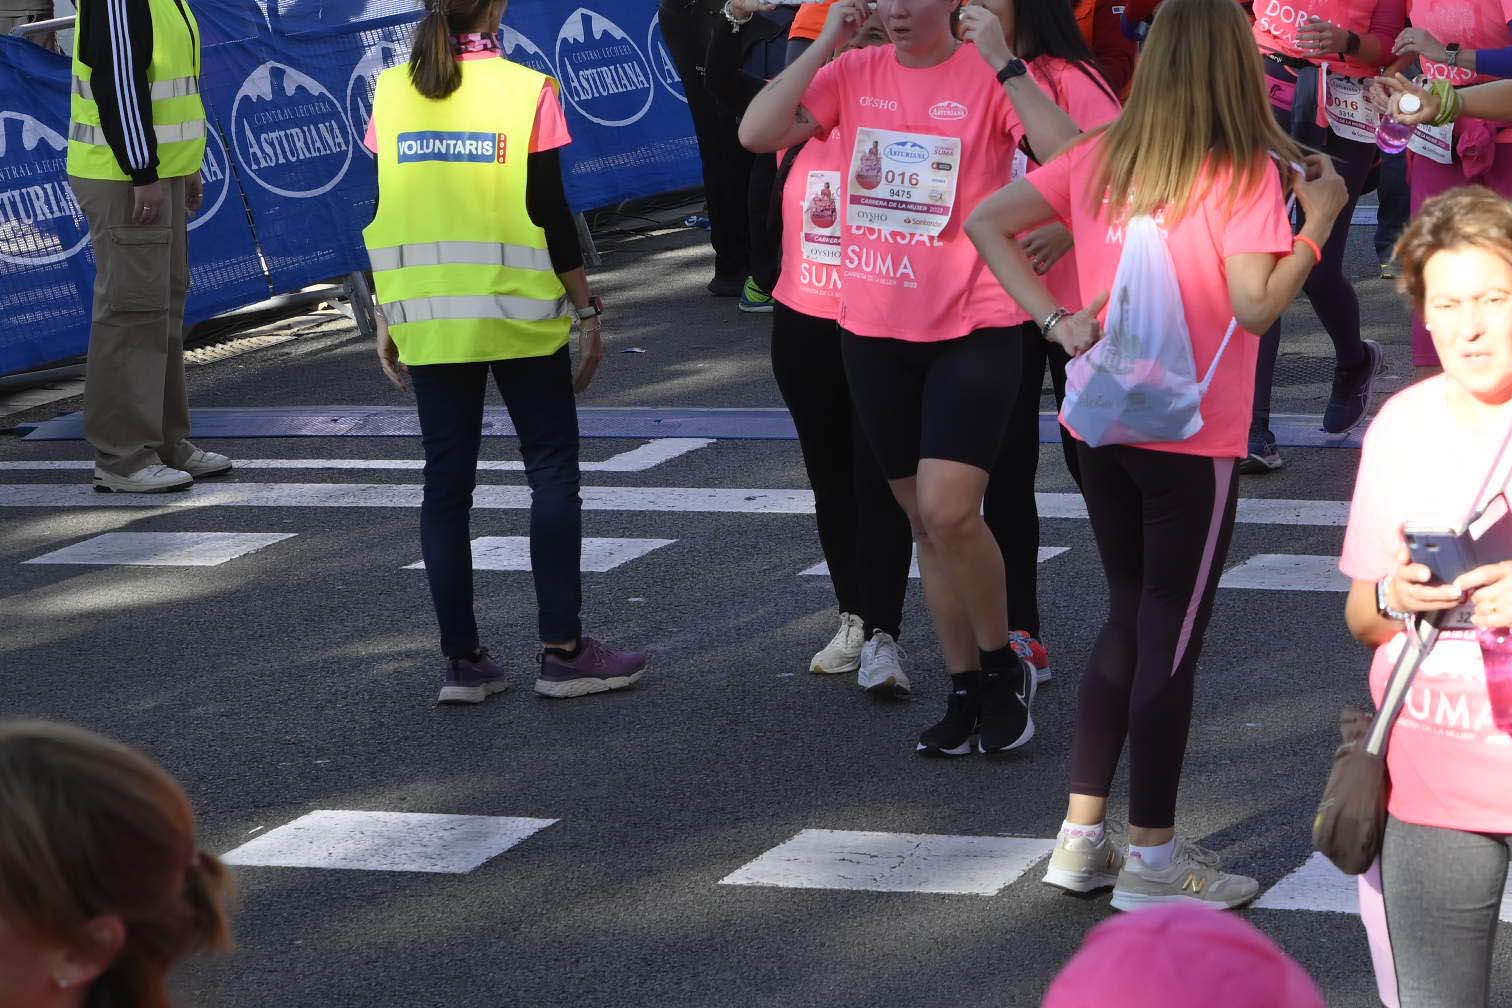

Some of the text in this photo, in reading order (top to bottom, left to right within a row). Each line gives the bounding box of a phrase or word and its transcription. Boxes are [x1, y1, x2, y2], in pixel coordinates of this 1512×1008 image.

[572, 44, 633, 63] CENTRAL LECHERA
[564, 56, 649, 102] ASTURIANA
[1334, 97, 1359, 111] 016
[254, 101, 333, 126] CENTRAL LECHERA
[243, 118, 348, 170] ASTURIANA
[398, 140, 494, 156] VOLUNTARIS
[886, 147, 927, 161] ASTURIANA
[884, 169, 920, 187] 016
[889, 188, 912, 200] 9475
[857, 210, 888, 222] OYSHO
[845, 244, 916, 280] SUMA
